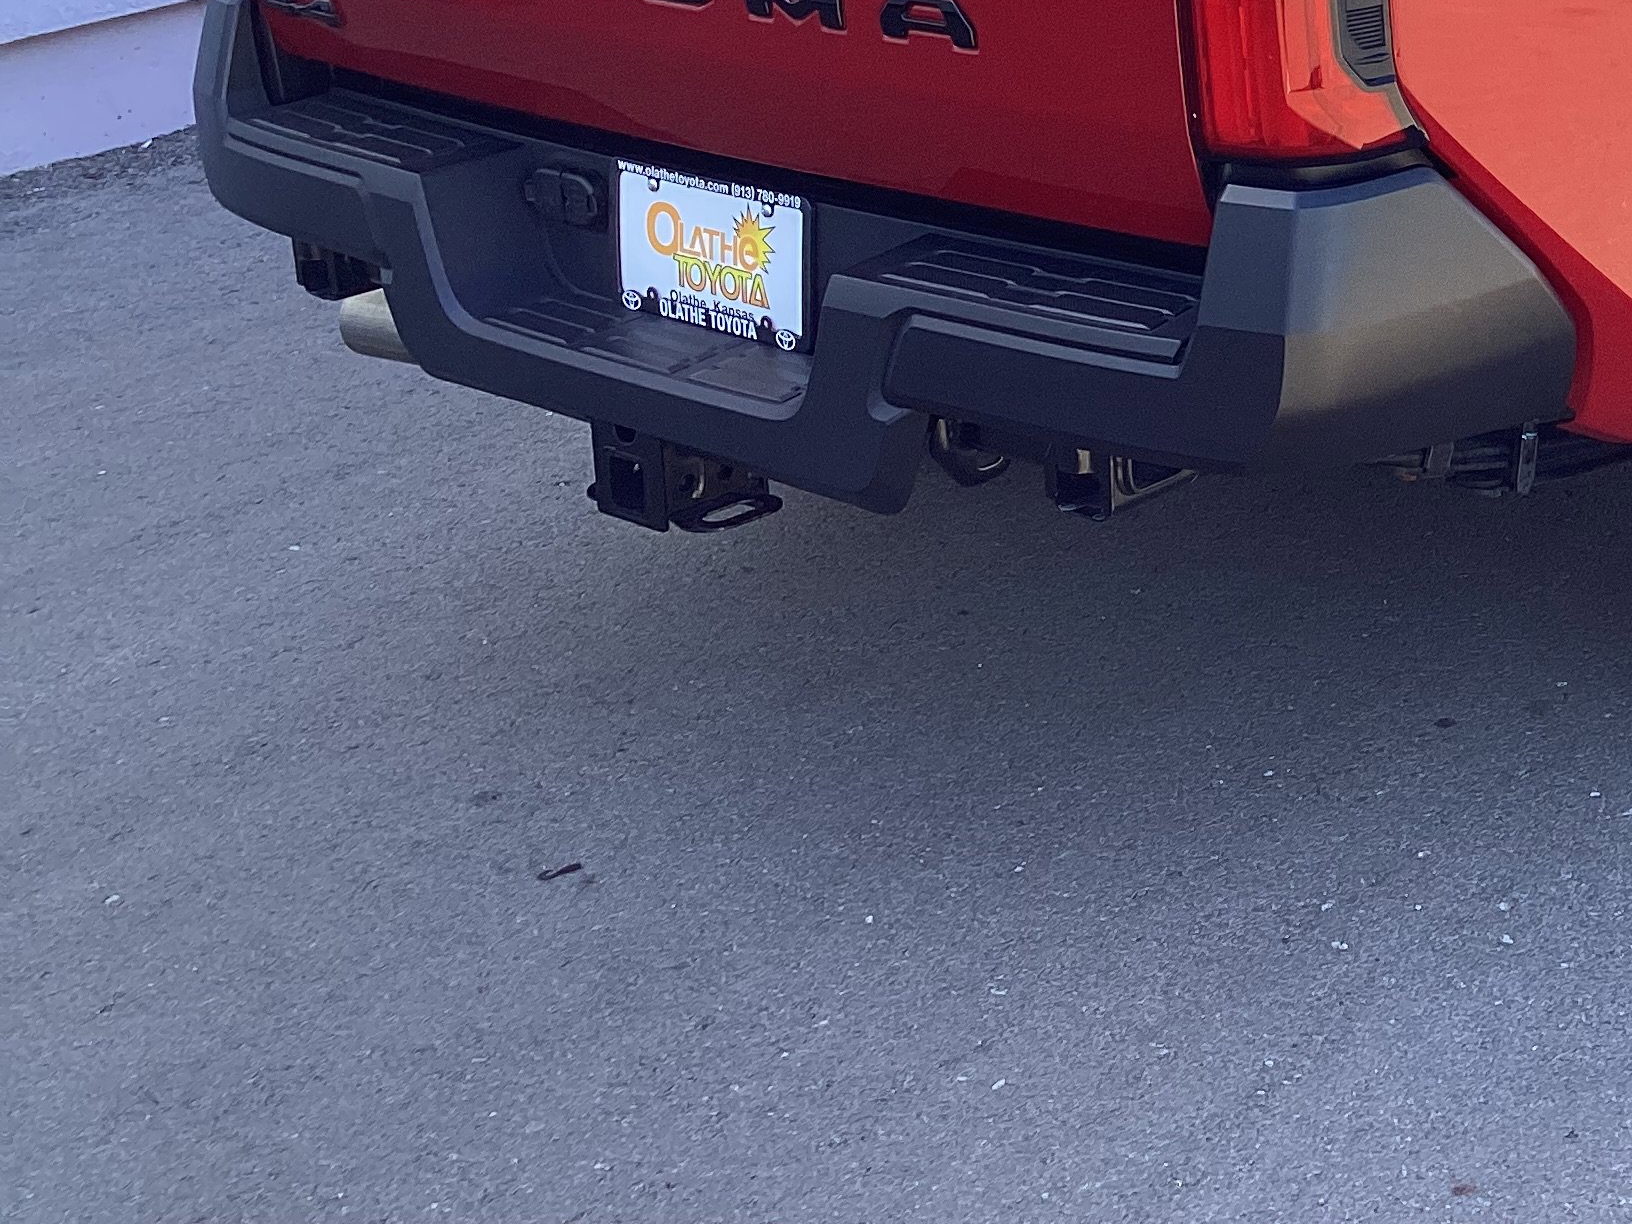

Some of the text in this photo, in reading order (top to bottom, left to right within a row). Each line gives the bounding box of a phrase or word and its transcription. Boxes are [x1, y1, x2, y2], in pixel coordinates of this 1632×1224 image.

[617, 159, 802, 210] www.olathetoyota.com (913) 780-9919
[673, 254, 770, 310] TOYOTA
[659, 298, 759, 341] OLATHE TOYOTA
[712, 299, 755, 321] Kansas
